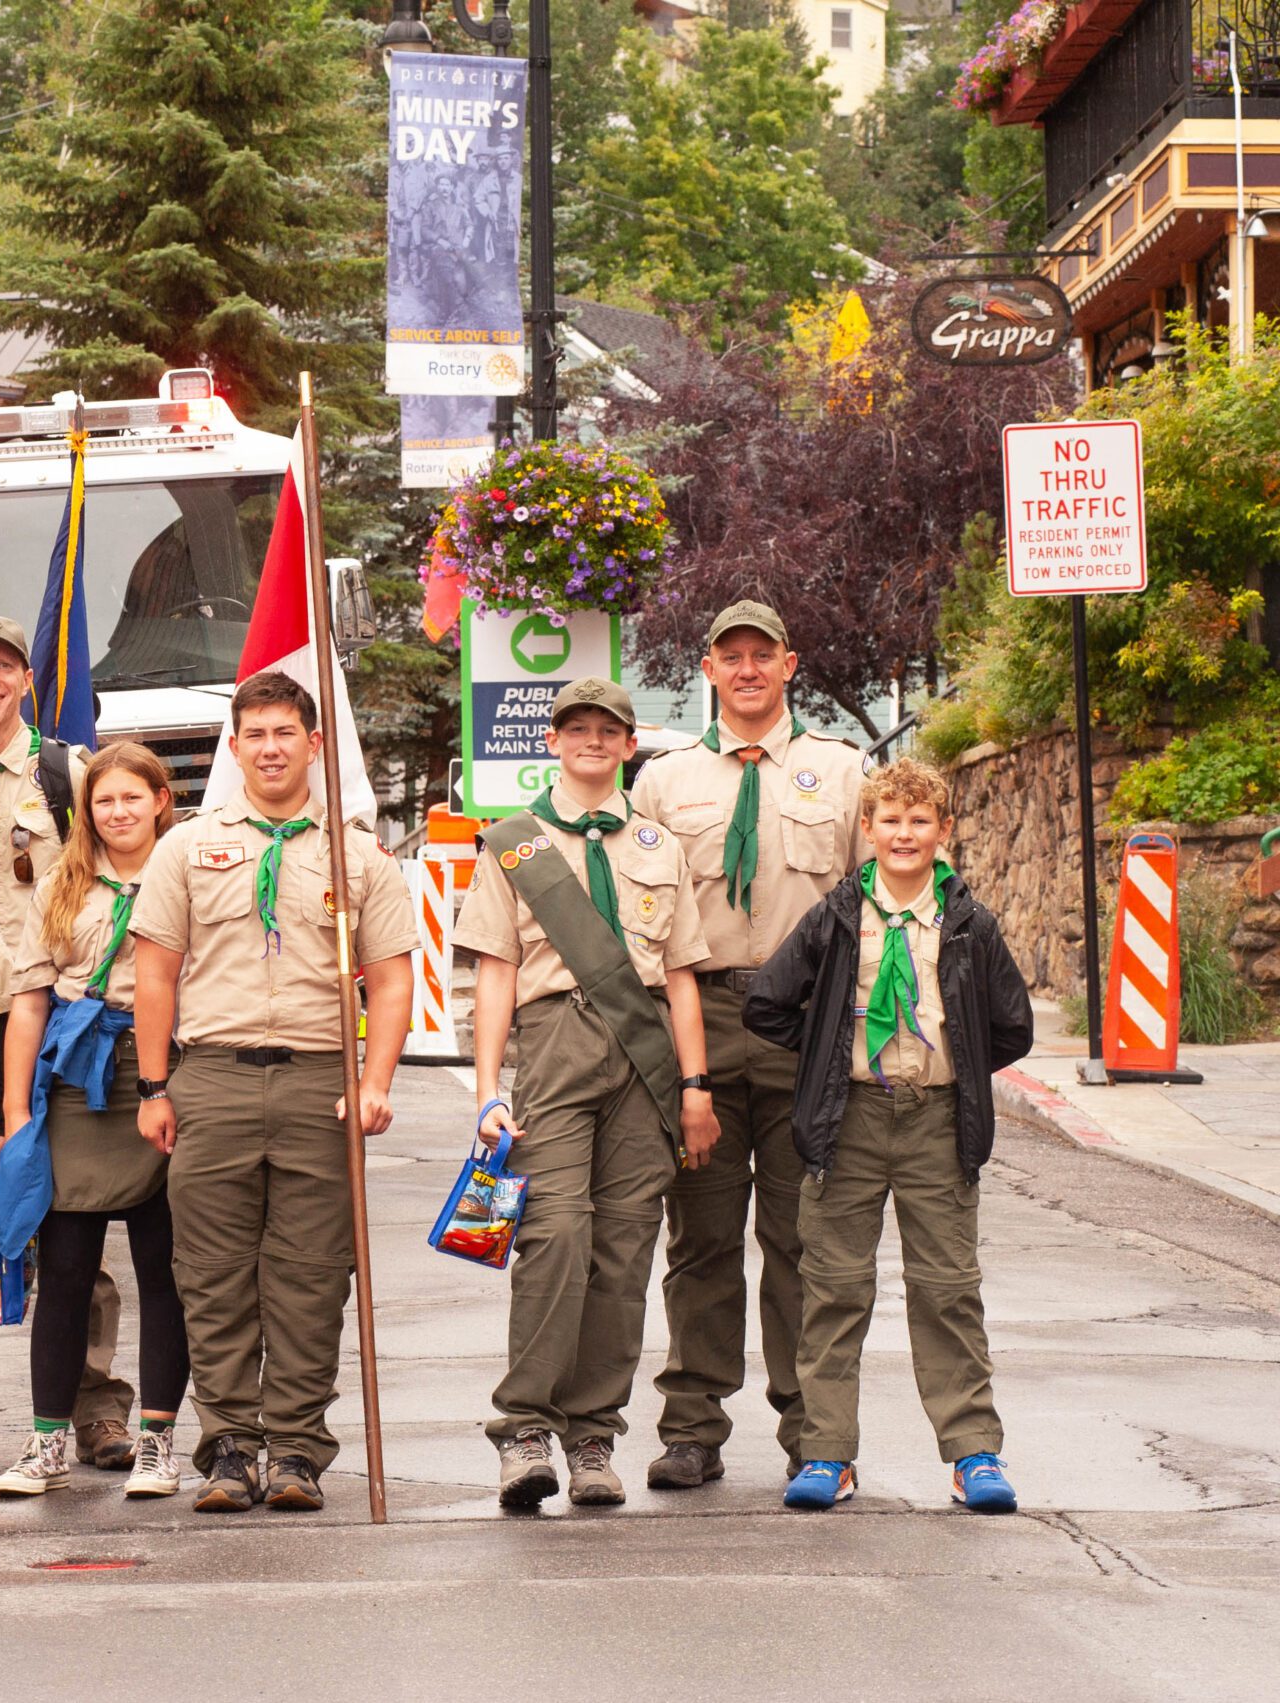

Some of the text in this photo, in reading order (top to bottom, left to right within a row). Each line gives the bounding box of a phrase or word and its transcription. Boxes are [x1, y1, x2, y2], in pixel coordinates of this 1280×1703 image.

[400, 68, 513, 89] park city
[396, 96, 519, 129] MINER'S
[396, 126, 477, 165] DAY
[389, 328, 521, 344] SERVICE ABOVE SELF
[931, 311, 1056, 359] Grappa
[428, 361, 482, 379] Rotary
[1055, 440, 1091, 462] NO
[406, 463, 444, 475] Rotary
[1040, 469, 1106, 492] THRU
[1022, 497, 1127, 521] TRAFFIC
[1020, 526, 1132, 543] RESIDENT PERMIT
[1029, 544, 1123, 560] PARKING ONLY
[1024, 563, 1132, 579] TOW ENFORCED
[504, 687, 561, 702] PUBL
[496, 704, 552, 719] PARK
[493, 725, 549, 738] RETUR
[485, 741, 530, 755] MAIN
